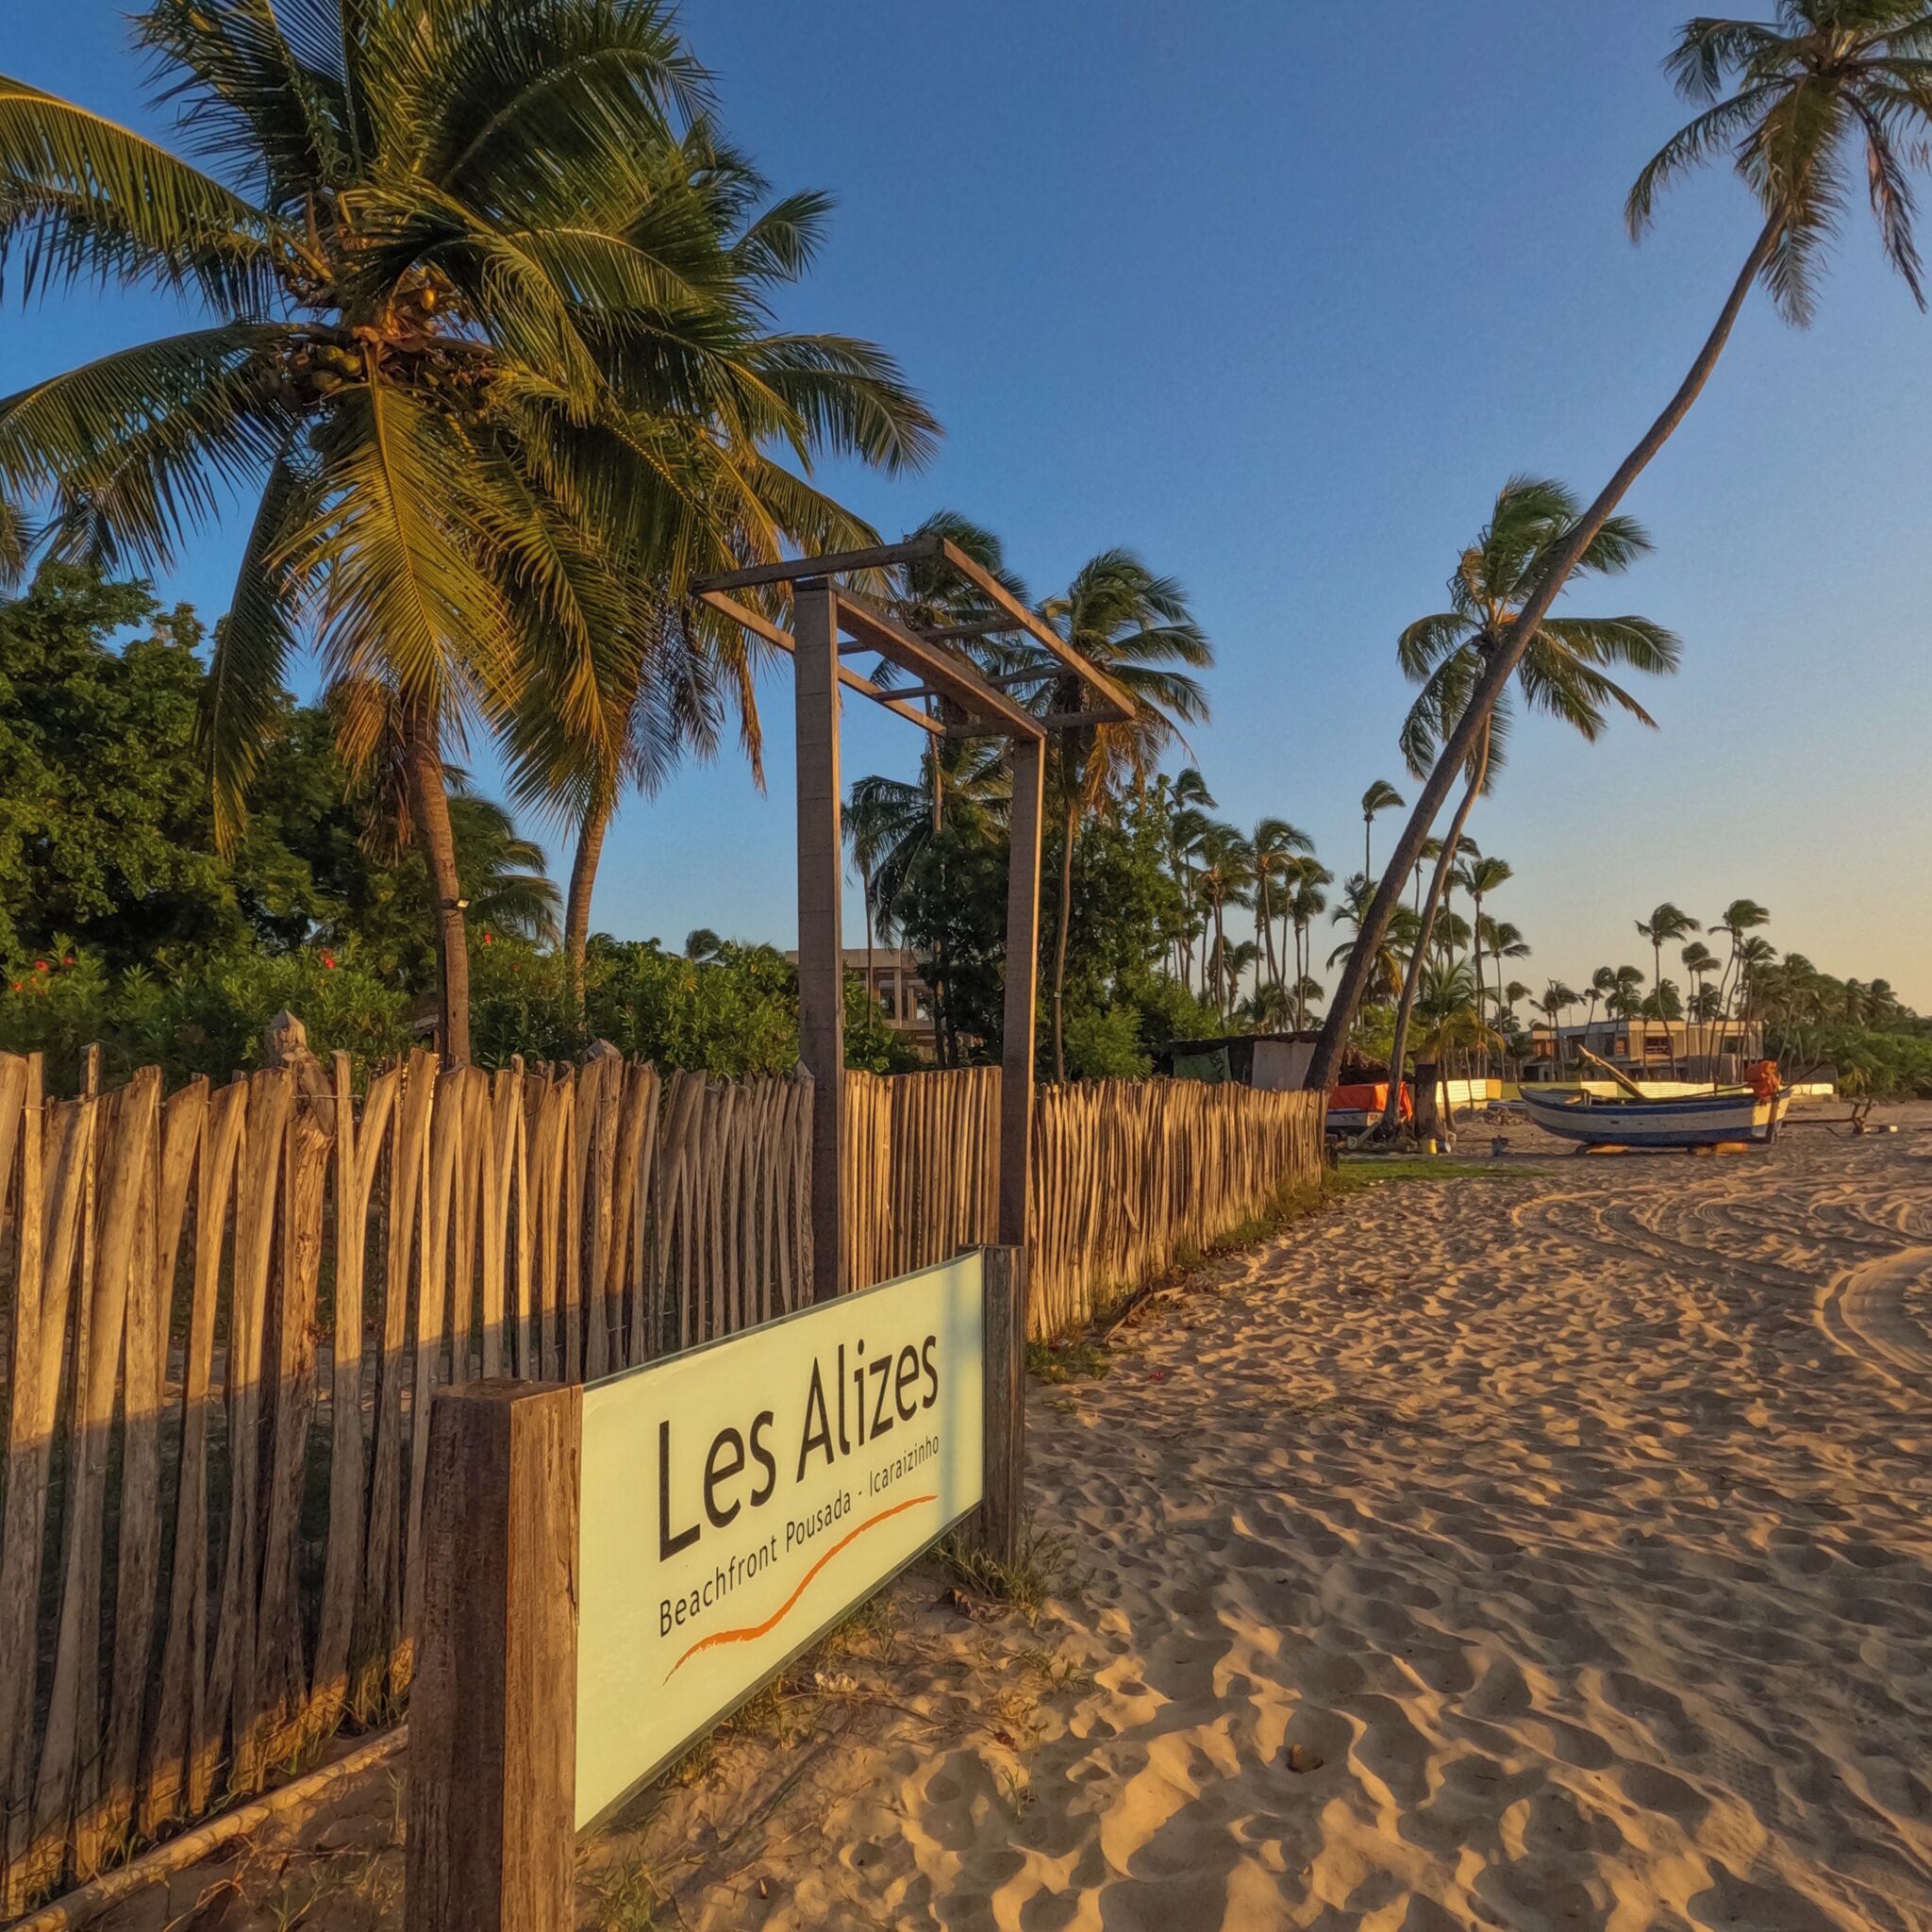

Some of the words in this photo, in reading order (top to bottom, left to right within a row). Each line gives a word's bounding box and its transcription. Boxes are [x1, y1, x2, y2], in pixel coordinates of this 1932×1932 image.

[658, 1410, 776, 1563] Les
[795, 1334, 940, 1485] Alizes
[659, 1535, 778, 1639] Beachfront
[786, 1488, 851, 1553] Pousada
[869, 1434, 940, 1499] Icaraizinho
